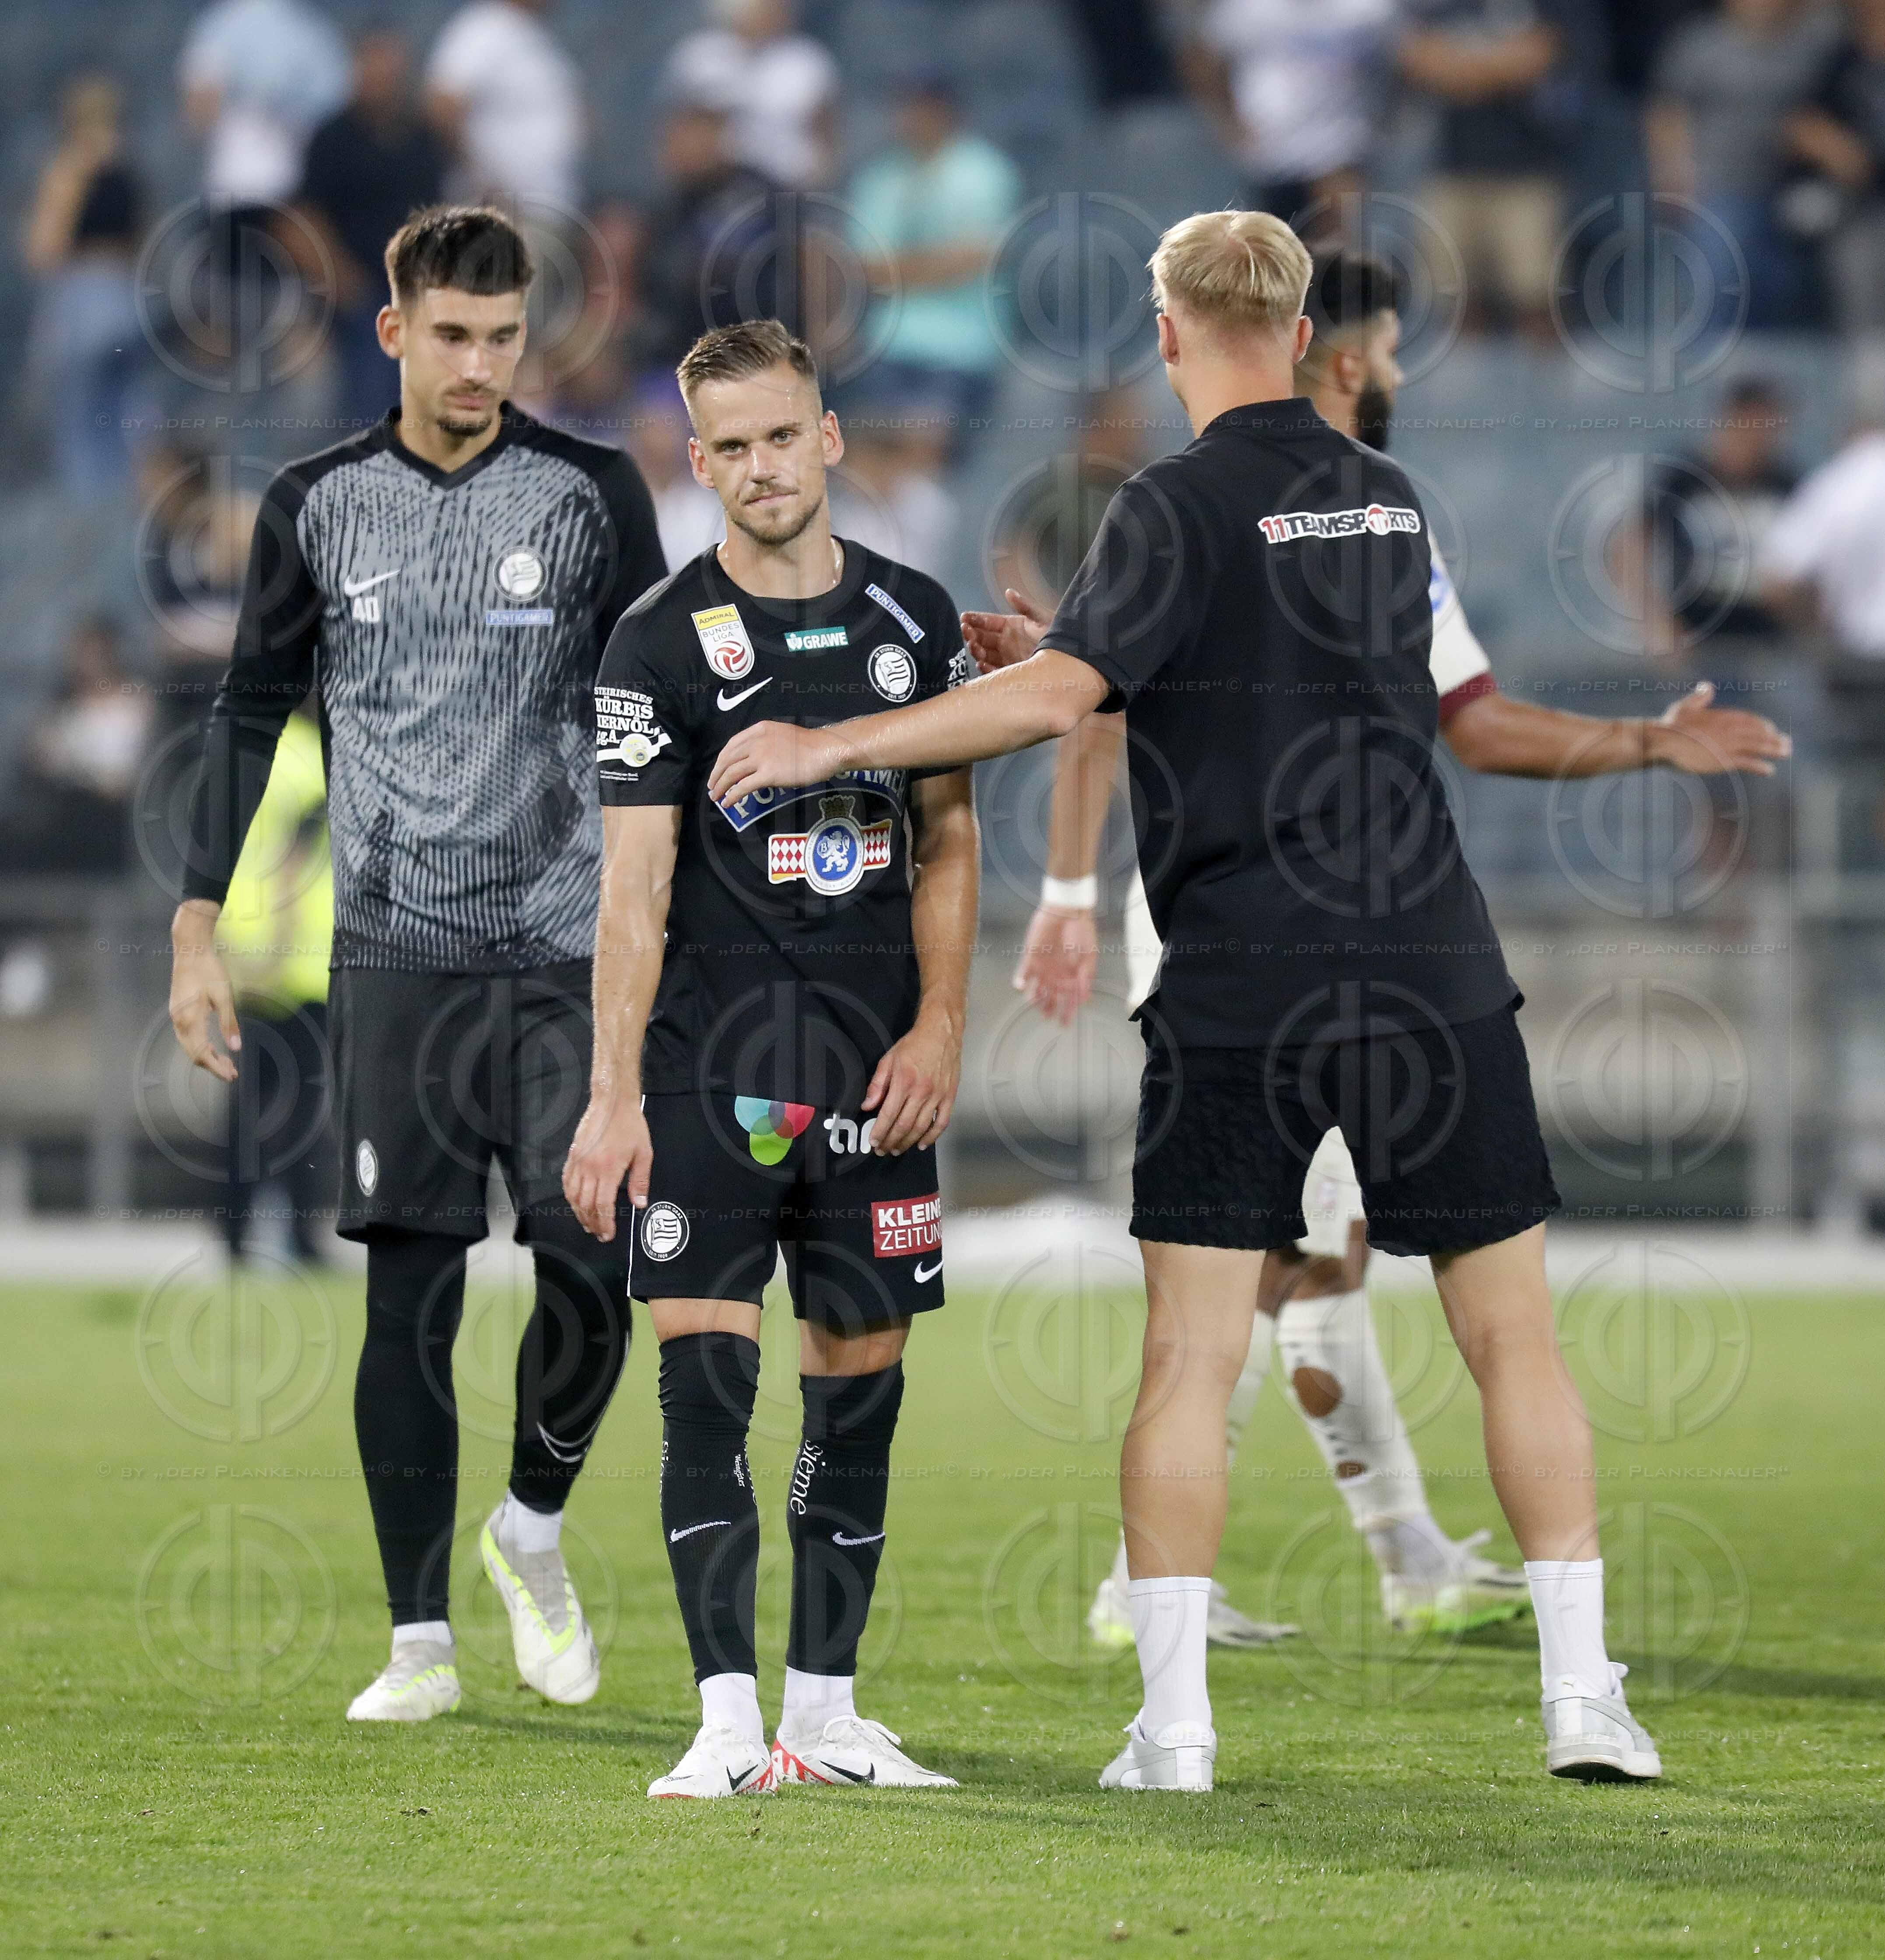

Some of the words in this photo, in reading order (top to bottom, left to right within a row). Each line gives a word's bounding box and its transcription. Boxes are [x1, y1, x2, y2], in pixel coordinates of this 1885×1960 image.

[353, 598, 379, 622] 40
[700, 612, 734, 624] ADMIRAL
[870, 588, 919, 637] PUNTIGAMER
[702, 623, 739, 637] BUNDES
[713, 631, 734, 642] LIGA
[802, 632, 848, 649] GRAWE
[594, 686, 654, 705] STEIRISCHES
[595, 695, 654, 719] KÜRBIS
